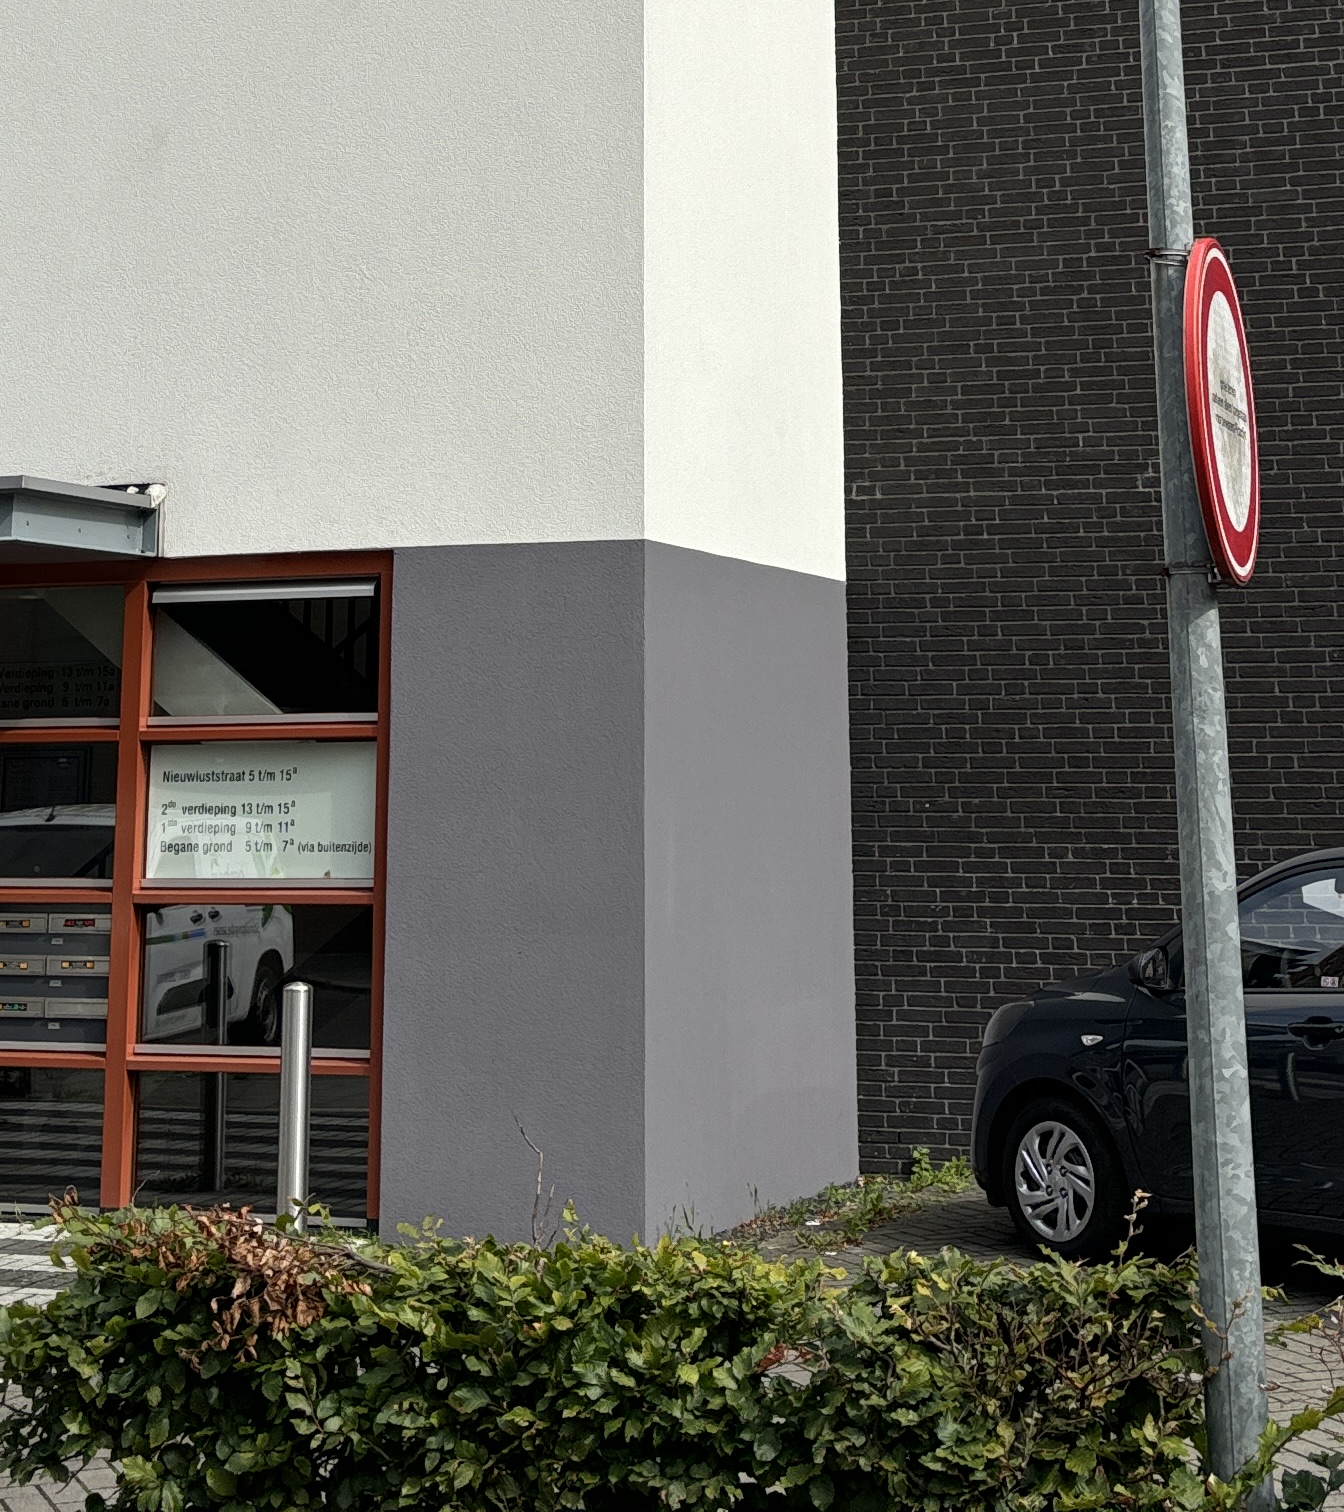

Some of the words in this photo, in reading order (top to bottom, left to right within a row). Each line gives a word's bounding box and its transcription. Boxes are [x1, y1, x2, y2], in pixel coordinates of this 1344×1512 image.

[76, 665, 94, 677] t/m
[74, 681, 93, 692] t/m
[22, 697, 55, 710] grond
[74, 696, 92, 707] t/m
[162, 769, 246, 783] Nieuwluststraat
[248, 769, 255, 782] 5
[258, 769, 276, 782] t/m
[181, 802, 237, 817] verdieping
[241, 802, 253, 815] 13
[256, 802, 274, 815] t/m
[181, 821, 237, 836] verdieping
[245, 821, 252, 834] 9
[255, 821, 273, 834] t/m
[160, 840, 199, 855] Begane
[202, 839, 233, 855] grond
[245, 840, 252, 853] 5
[254, 839, 273, 853] t/m
[297, 841, 315, 855] (via
[317, 841, 372, 856] buitenzijde)
